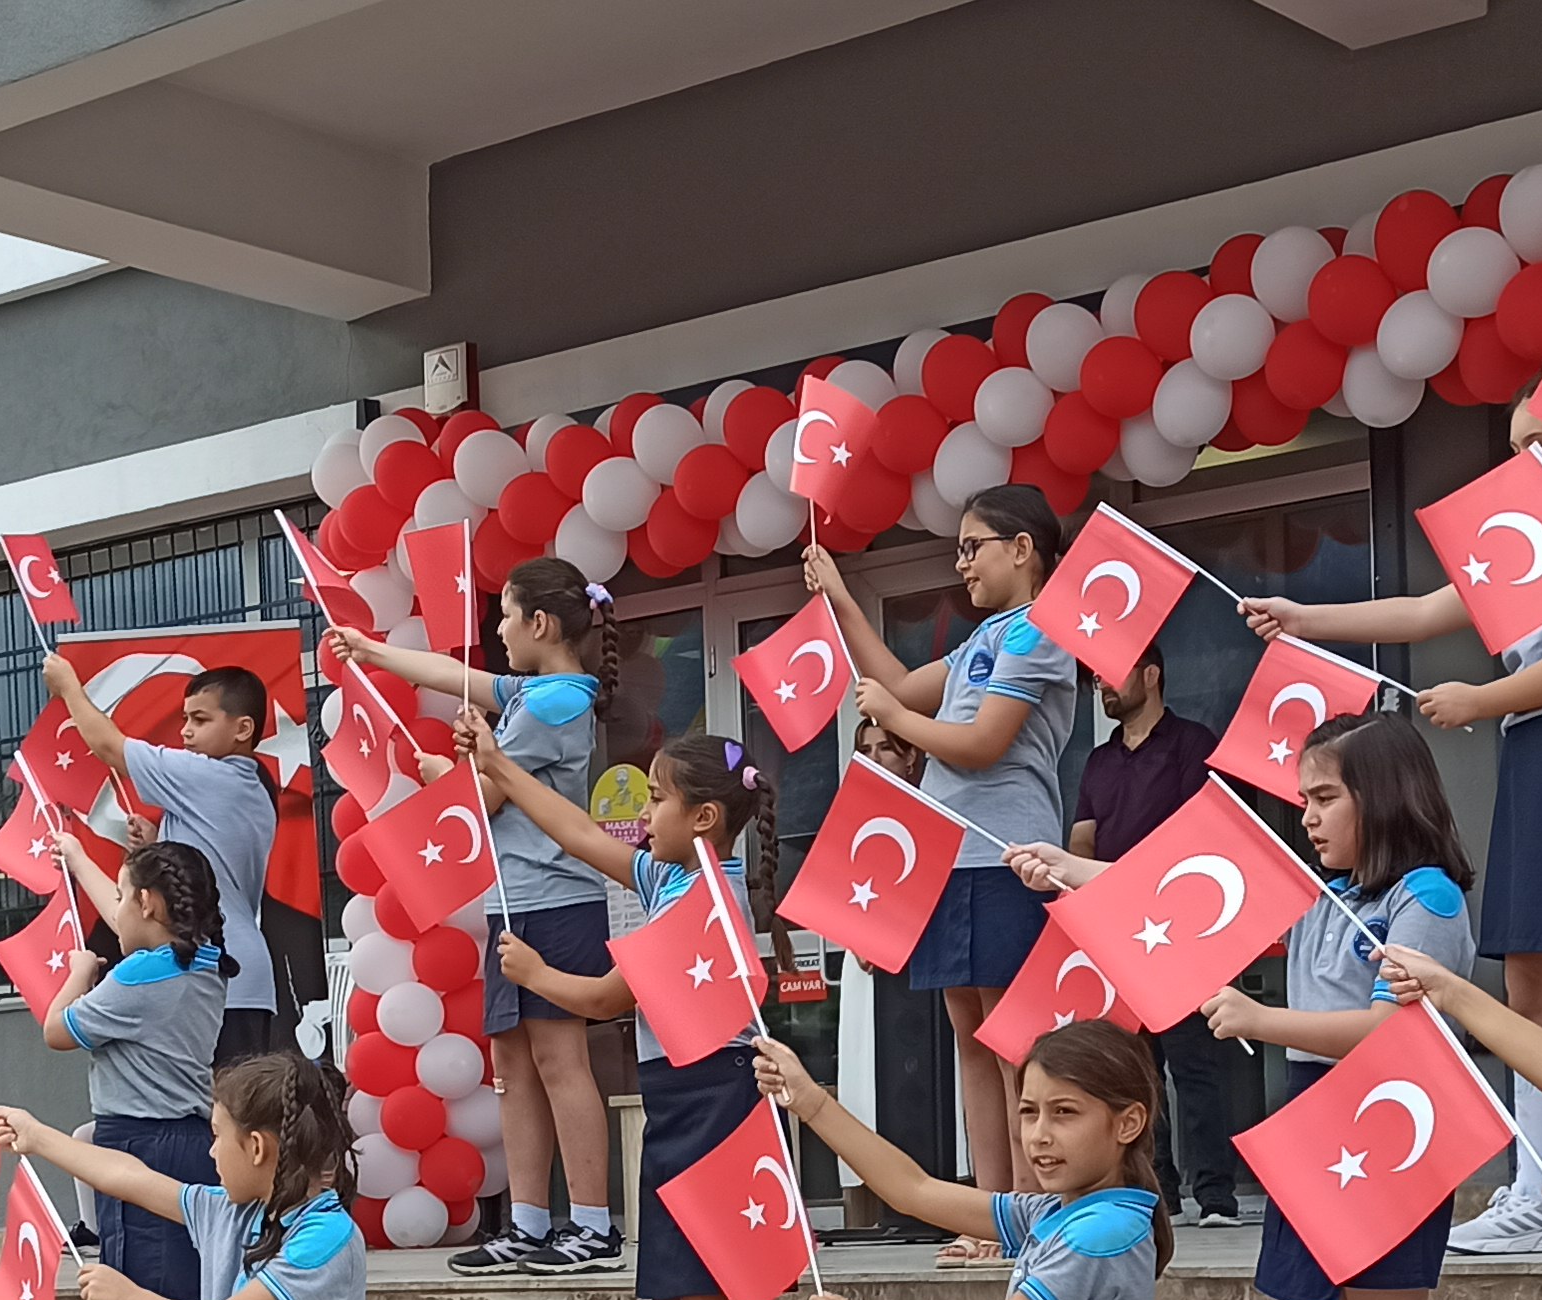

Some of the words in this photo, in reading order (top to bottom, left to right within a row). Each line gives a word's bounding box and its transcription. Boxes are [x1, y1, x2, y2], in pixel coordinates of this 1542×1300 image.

[605, 821, 639, 830] MASKE
[780, 980, 801, 993] CAM
[802, 980, 821, 991] VAR
